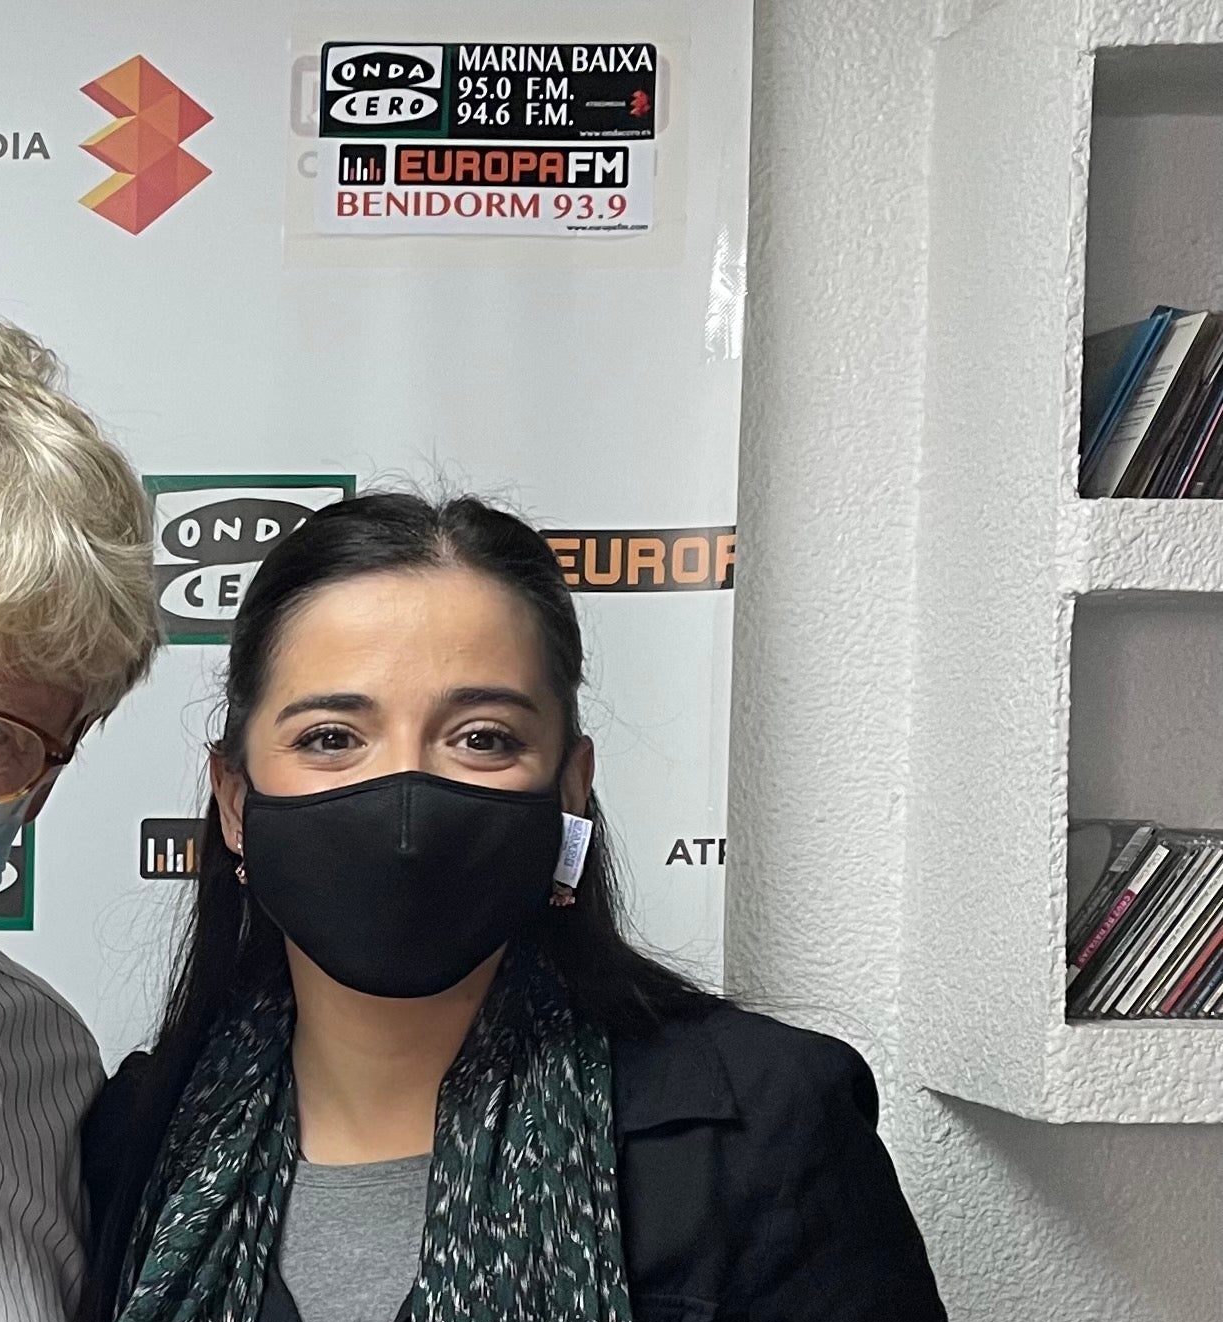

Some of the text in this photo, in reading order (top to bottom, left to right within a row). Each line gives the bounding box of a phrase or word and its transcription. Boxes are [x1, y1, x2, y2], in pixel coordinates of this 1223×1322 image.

[458, 45, 654, 73] MARINA BAIXA
[341, 62, 425, 81] ONDA
[458, 76, 575, 100] 95.0 F.M.
[345, 96, 424, 116] CERO
[457, 102, 574, 126] 94.6 F.M.
[337, 191, 627, 219] BENIDORM 93.9
[178, 517, 307, 547] OND
